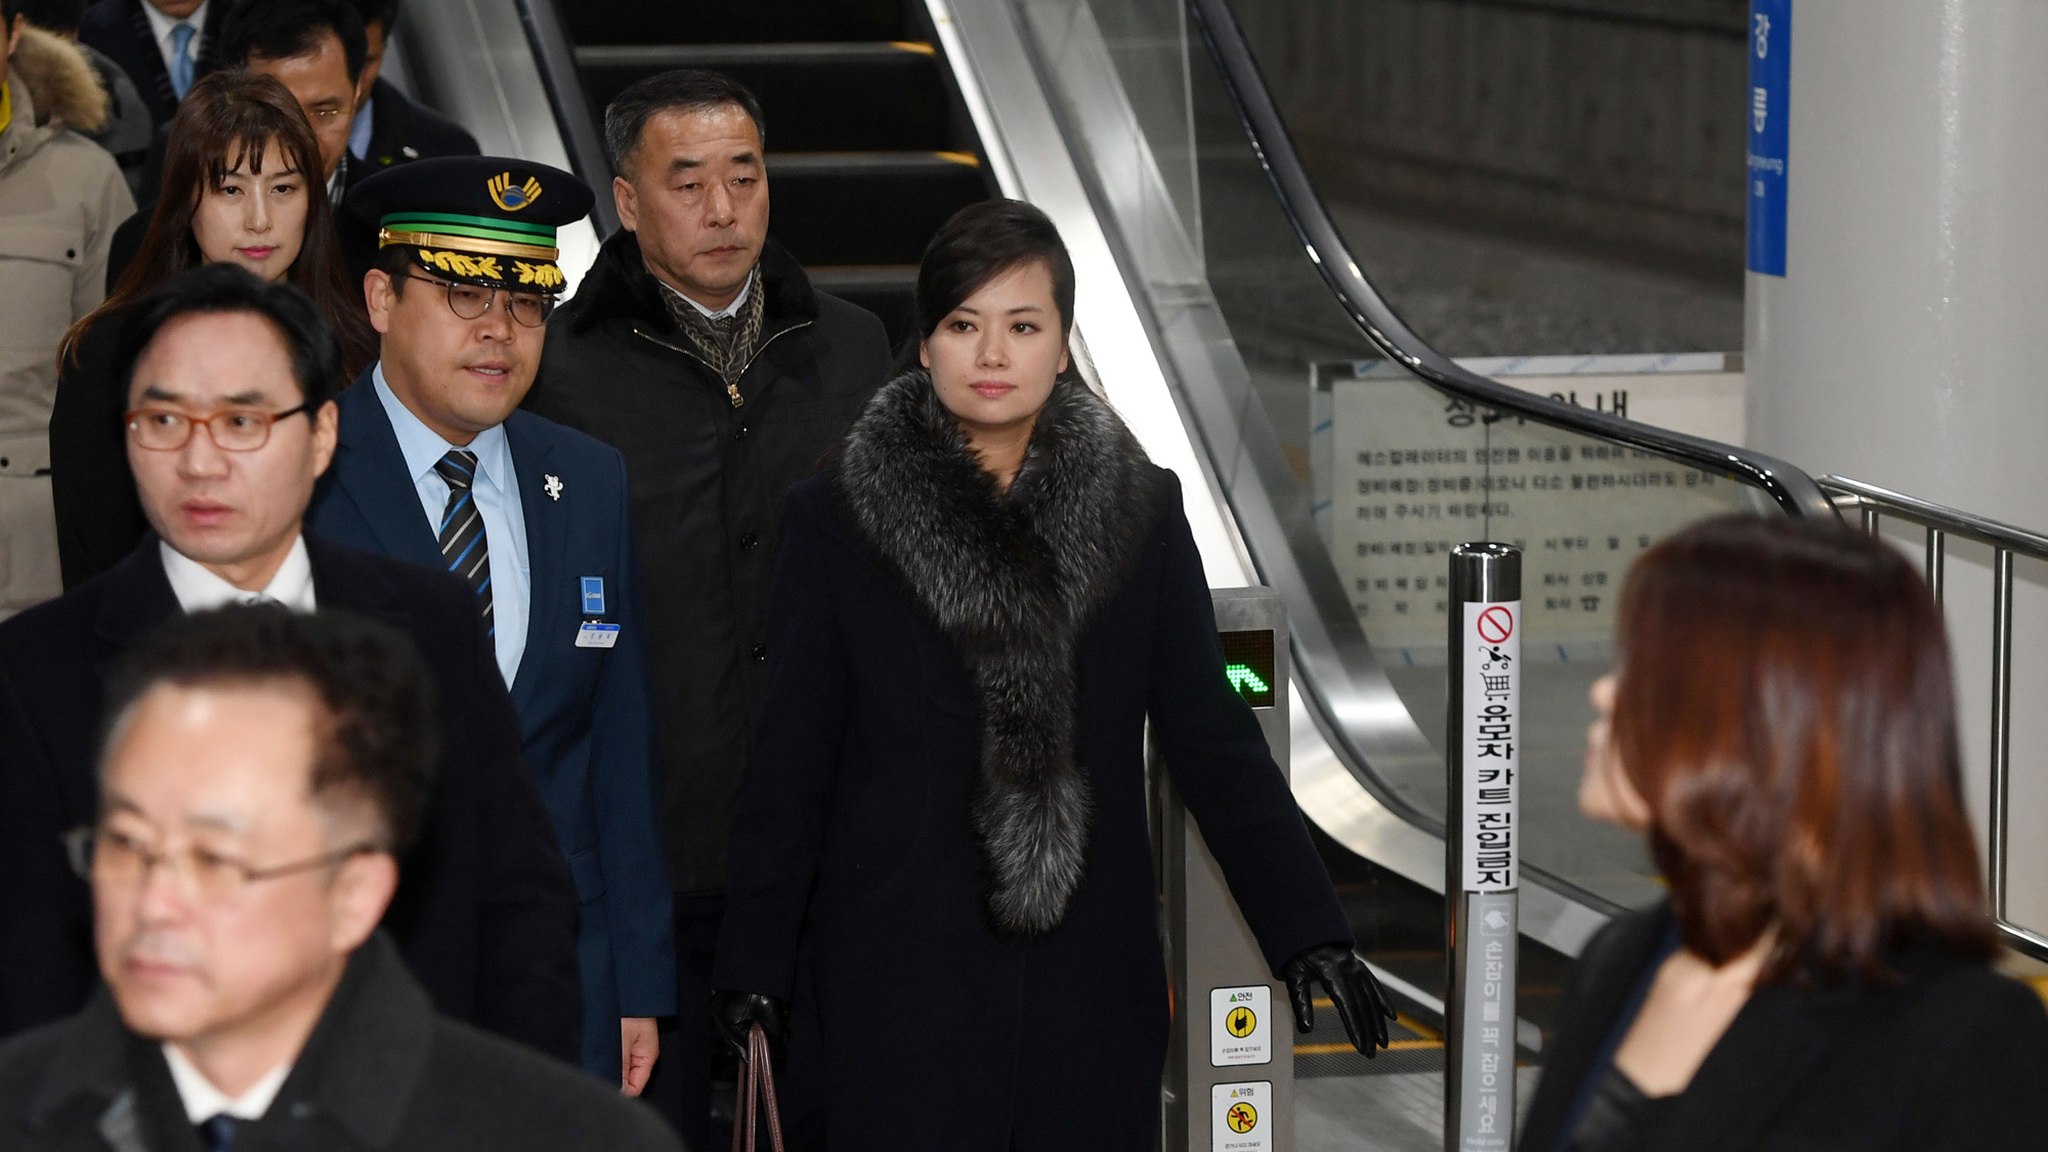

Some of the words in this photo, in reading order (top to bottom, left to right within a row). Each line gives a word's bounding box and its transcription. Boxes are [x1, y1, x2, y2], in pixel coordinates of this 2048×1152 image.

[1477, 705, 1515, 760] 유모차
[1477, 769, 1514, 805] 카트
[1477, 812, 1512, 887] 진입금지
[1237, 991, 1253, 1001] 안전
[1483, 940, 1505, 1022] 손잡이를
[1238, 1086, 1254, 1097] 위험
[1478, 1052, 1501, 1134] 잡으세요
